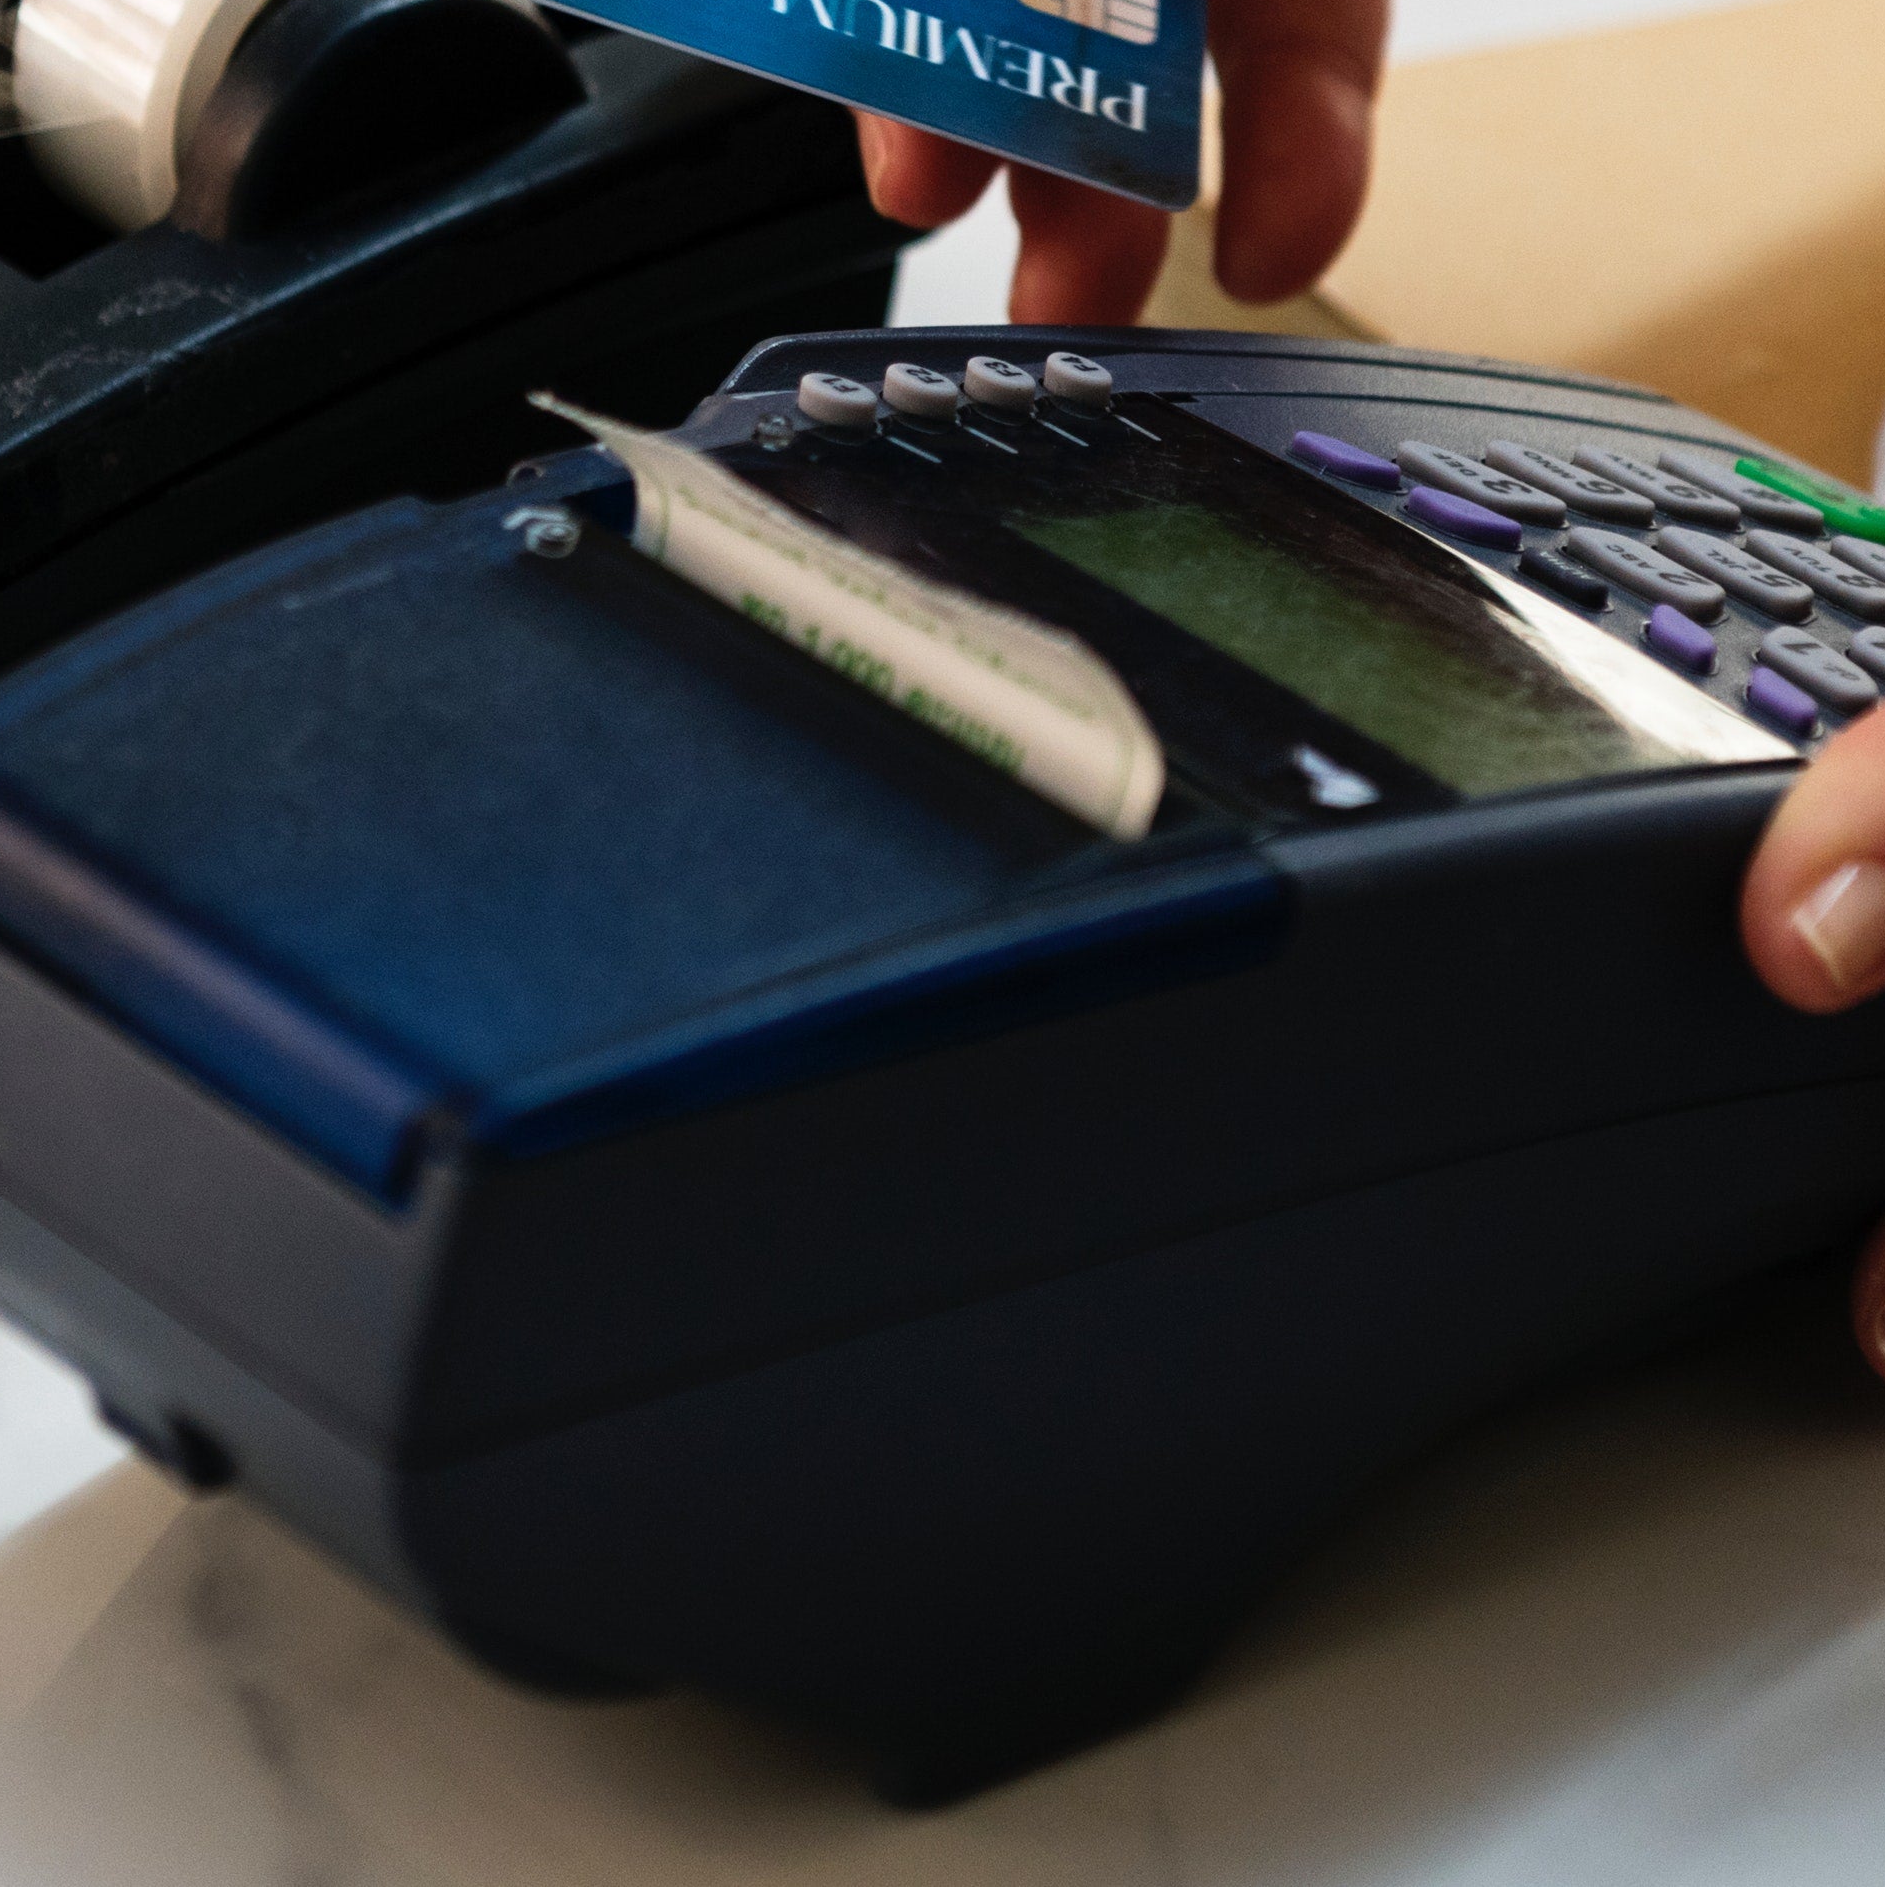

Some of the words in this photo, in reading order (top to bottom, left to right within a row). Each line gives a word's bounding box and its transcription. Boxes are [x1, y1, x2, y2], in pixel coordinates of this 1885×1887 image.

[984, 361, 1022, 377] F3
[1061, 356, 1099, 372] F4
[906, 368, 944, 384] F2
[822, 377, 859, 393] F1
[1482, 479, 1533, 494] 3
[1575, 480, 1625, 494] 6
[1665, 484, 1713, 500] 9
[1606, 545, 1655, 569] ABC
[1783, 547, 1832, 573] TUV
[1658, 571, 1714, 586] 2
[1750, 573, 1803, 588] 5
[1781, 643, 1823, 655] 1
